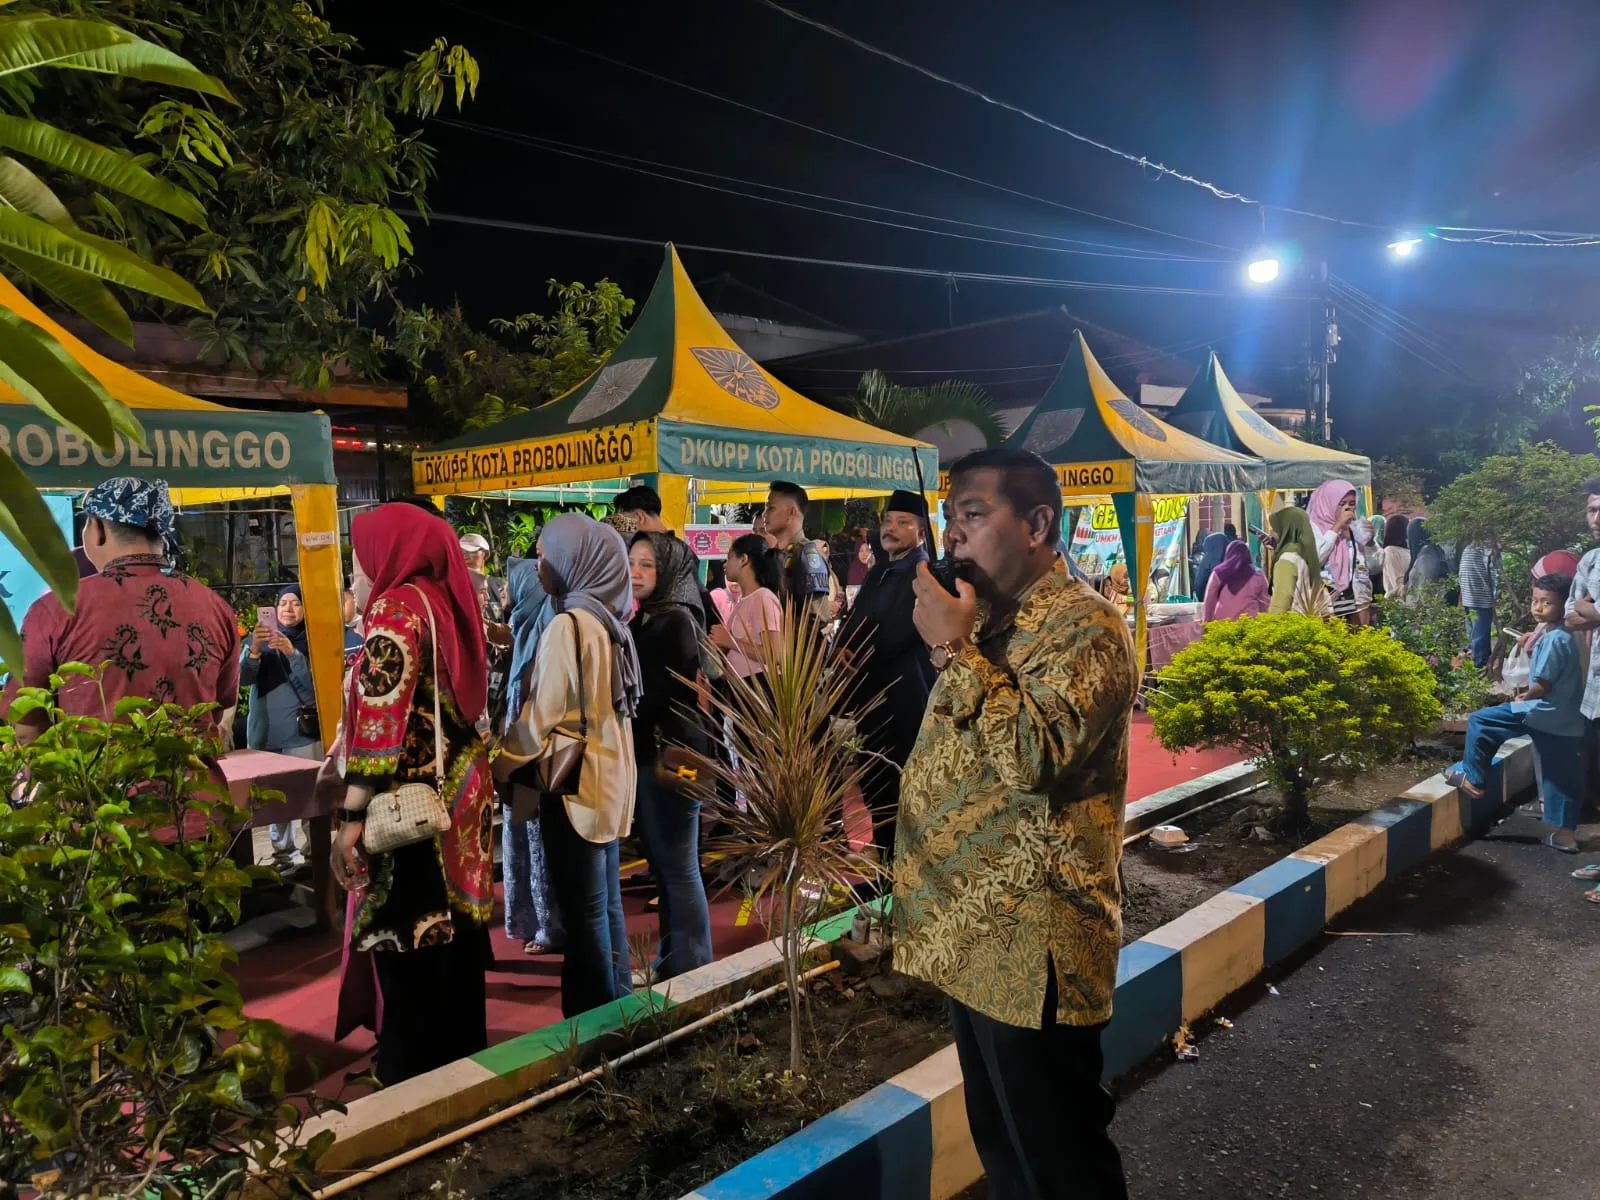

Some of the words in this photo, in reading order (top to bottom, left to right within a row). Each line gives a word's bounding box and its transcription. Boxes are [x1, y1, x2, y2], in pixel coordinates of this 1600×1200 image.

[426, 455, 468, 484] DKUPP
[473, 452, 508, 479] KOTA
[513, 433, 633, 475] PROBOLINGGO
[681, 436, 750, 469] DKUPP
[756, 444, 804, 473] KOTA
[810, 449, 924, 483] PROBOLINGGO
[1060, 466, 1114, 487] INGGO
